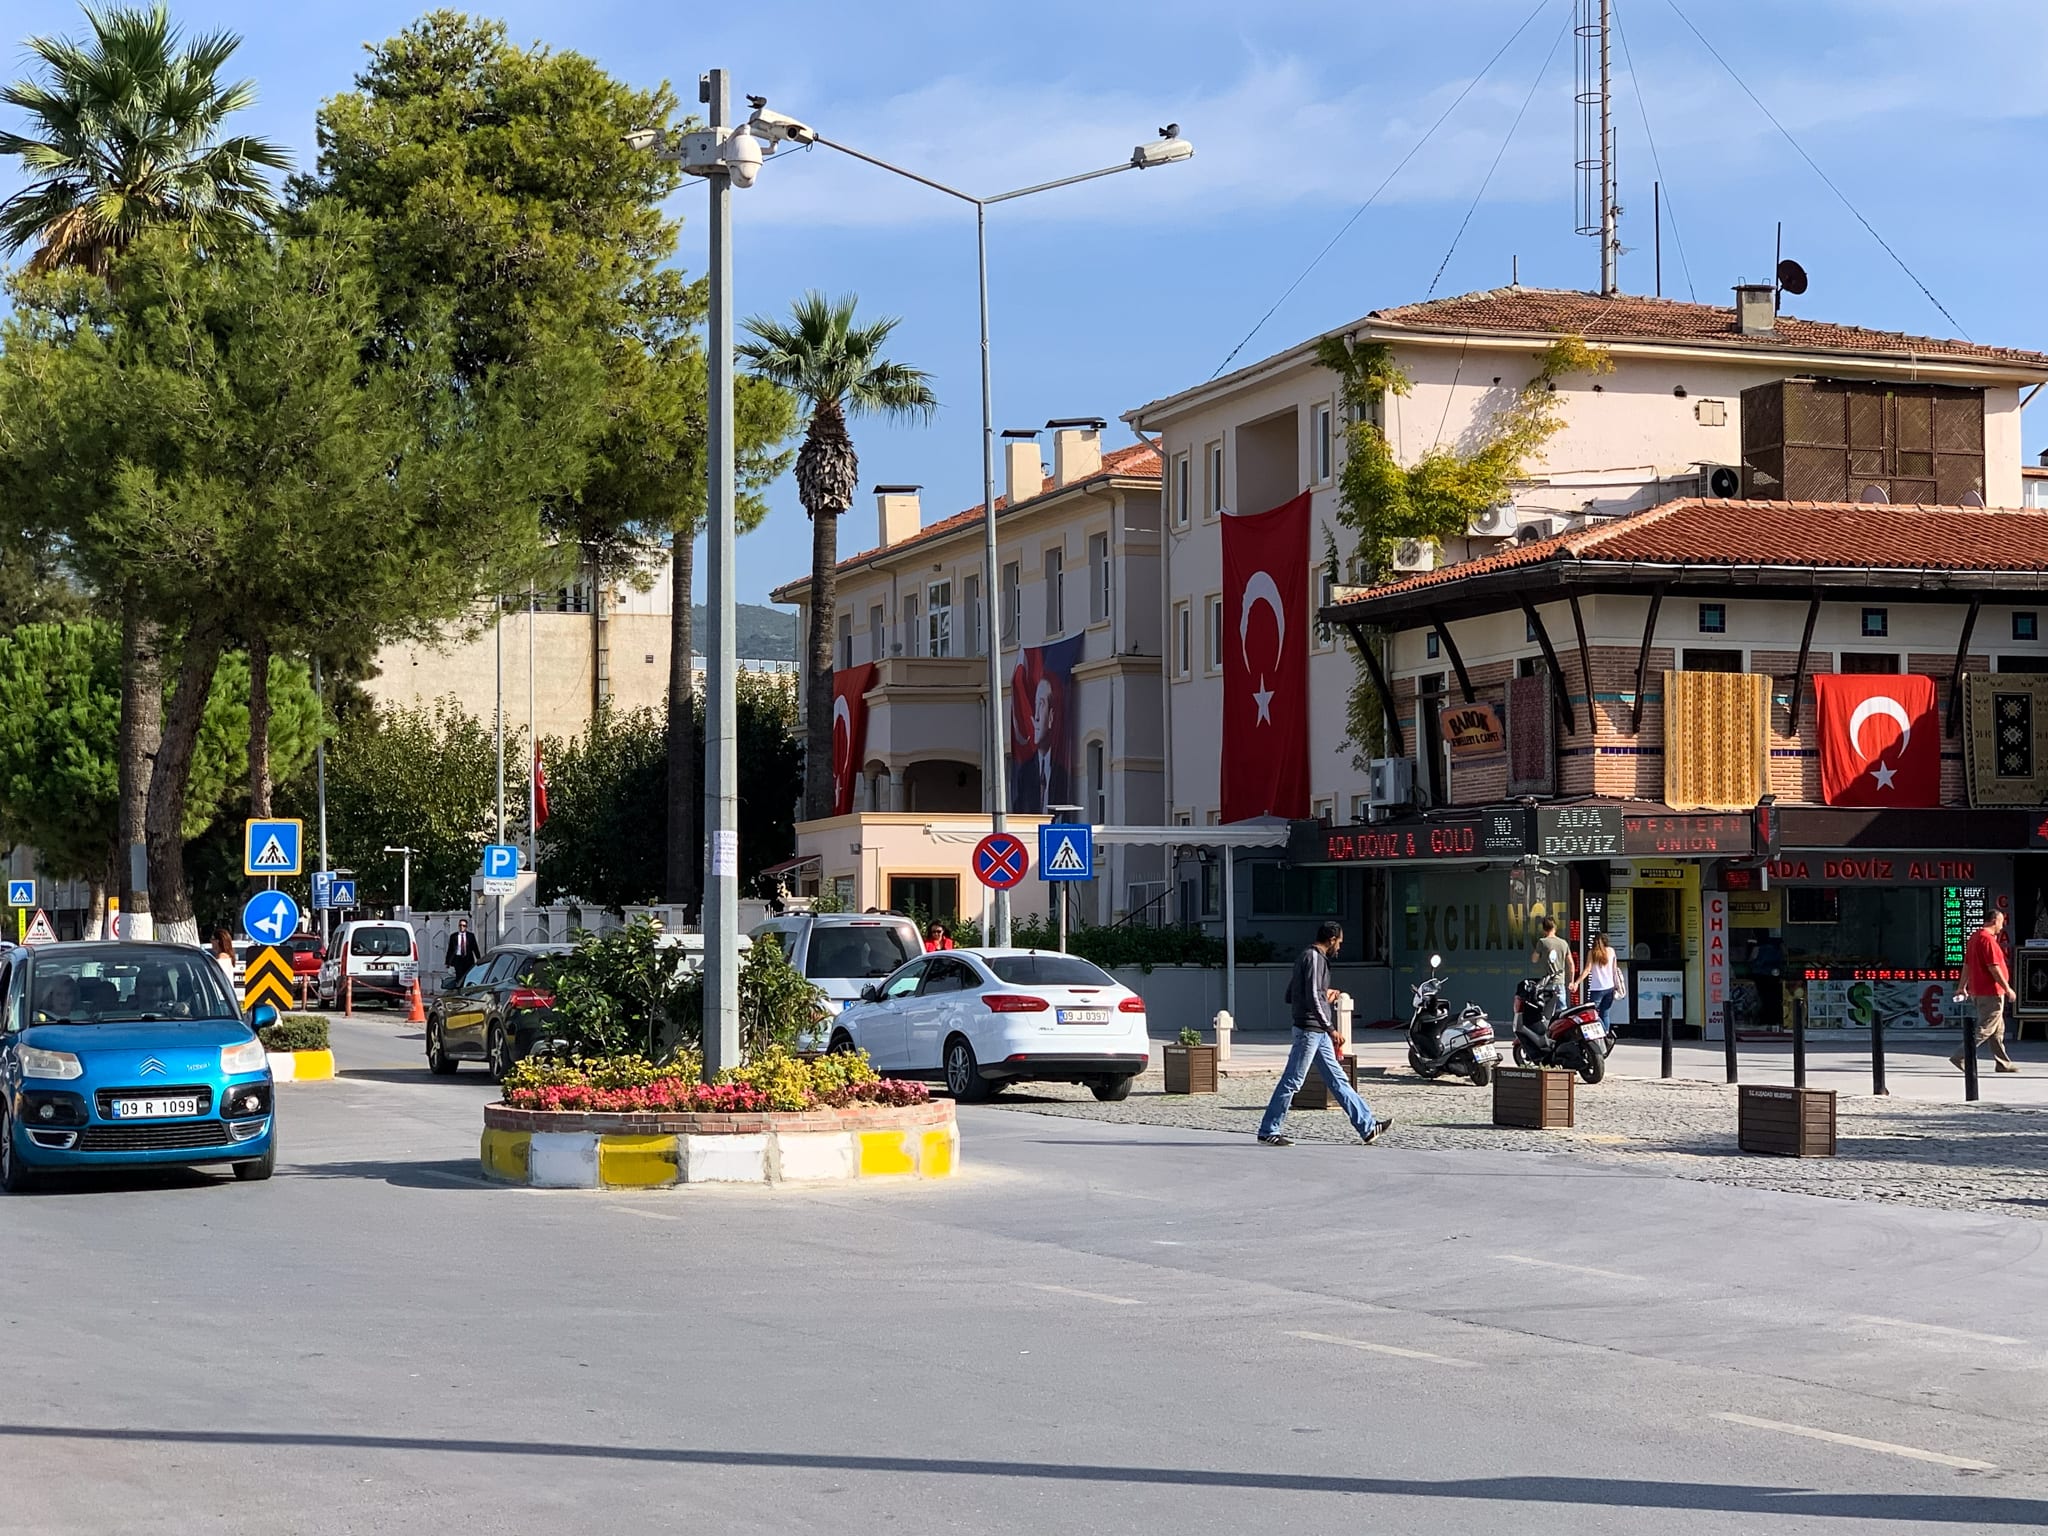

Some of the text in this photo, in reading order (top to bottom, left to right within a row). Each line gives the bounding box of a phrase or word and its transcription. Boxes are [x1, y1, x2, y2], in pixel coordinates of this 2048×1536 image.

[1494, 816, 1512, 835] NO
[1557, 809, 1603, 828] ADA
[1625, 818, 1742, 834] WESTERN
[1328, 836, 1355, 860] ADA
[1406, 832, 1416, 856] &
[1431, 827, 1475, 853] GOLD
[1544, 829, 1617, 854] DÖVİZ
[1655, 837, 1718, 851] UNION
[492, 849, 510, 875] P
[1766, 857, 1976, 880] ADA DÖVİZ ALTIN
[1405, 901, 1568, 951] EXCHANGE
[1710, 899, 1724, 1004] CHANGE
[1805, 970, 1960, 979] NO COMMISSIO
[1063, 1011, 1106, 1021] 09 J 0397
[122, 1100, 194, 1115] 09 R 1099
